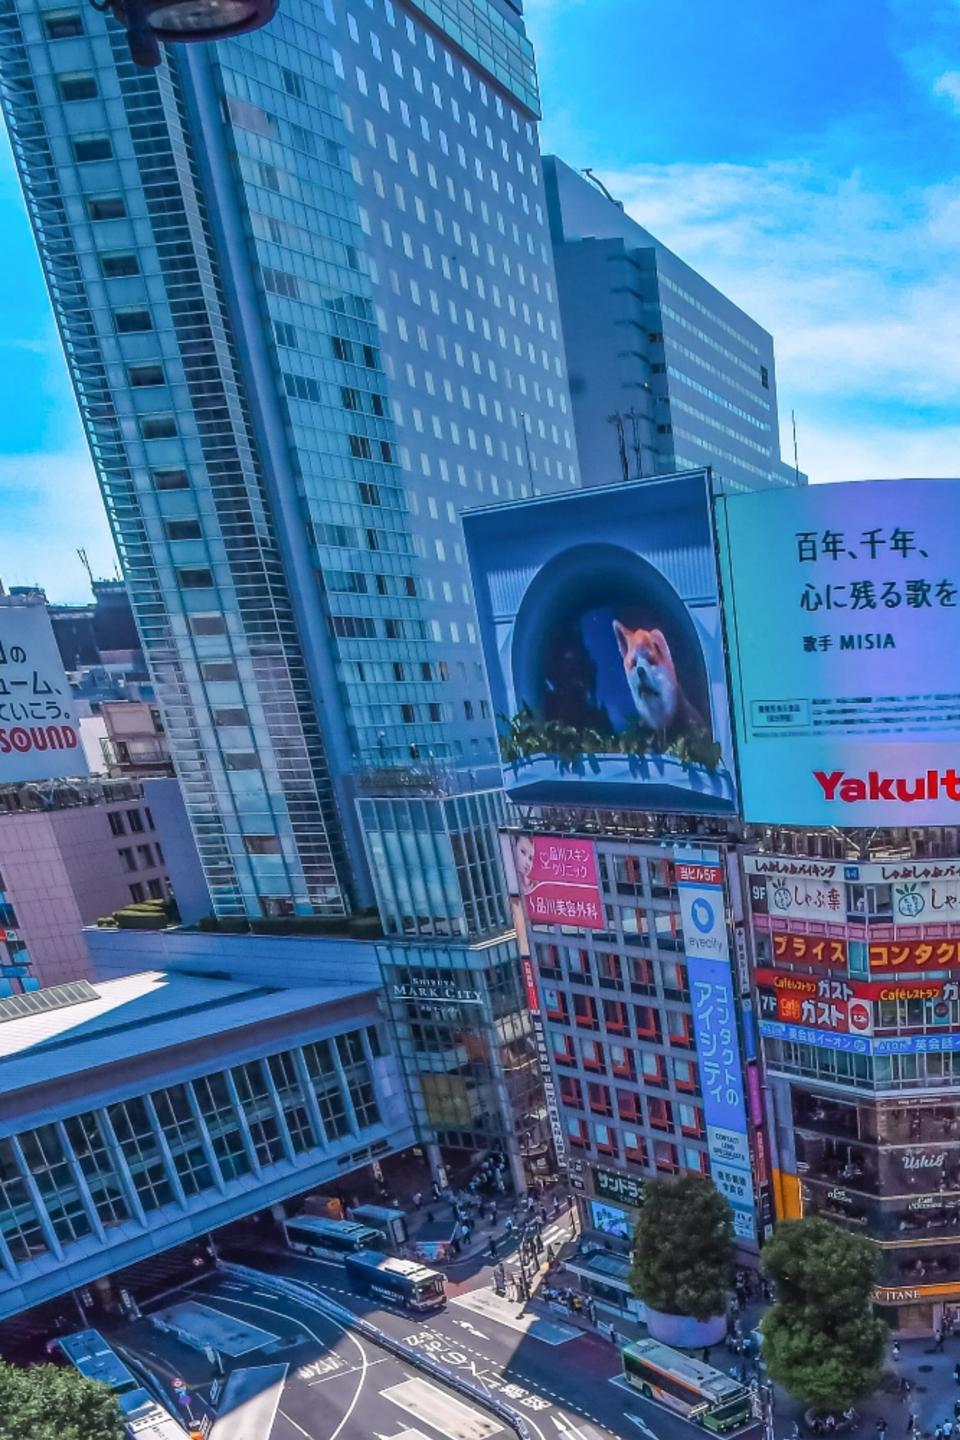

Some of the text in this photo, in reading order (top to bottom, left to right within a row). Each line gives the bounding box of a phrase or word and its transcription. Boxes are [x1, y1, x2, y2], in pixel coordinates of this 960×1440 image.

[796, 528, 929, 561] 百年、千年、
[803, 634, 896, 652] 歌手 MISIA
[752, 886, 766, 899] 9F
[794, 885, 840, 911] しゃぶ葉
[689, 937, 722, 952] eyecity
[774, 937, 846, 962] プライス
[412, 978, 455, 986] SHIBUYA
[818, 980, 853, 1001] ガスト
[393, 985, 482, 1001] MARK CITY
[761, 995, 777, 1011] 7F
[802, 999, 845, 1027] ガスト
[694, 981, 722, 1103] アイシティ
[715, 985, 739, 1106] コンタクトの
